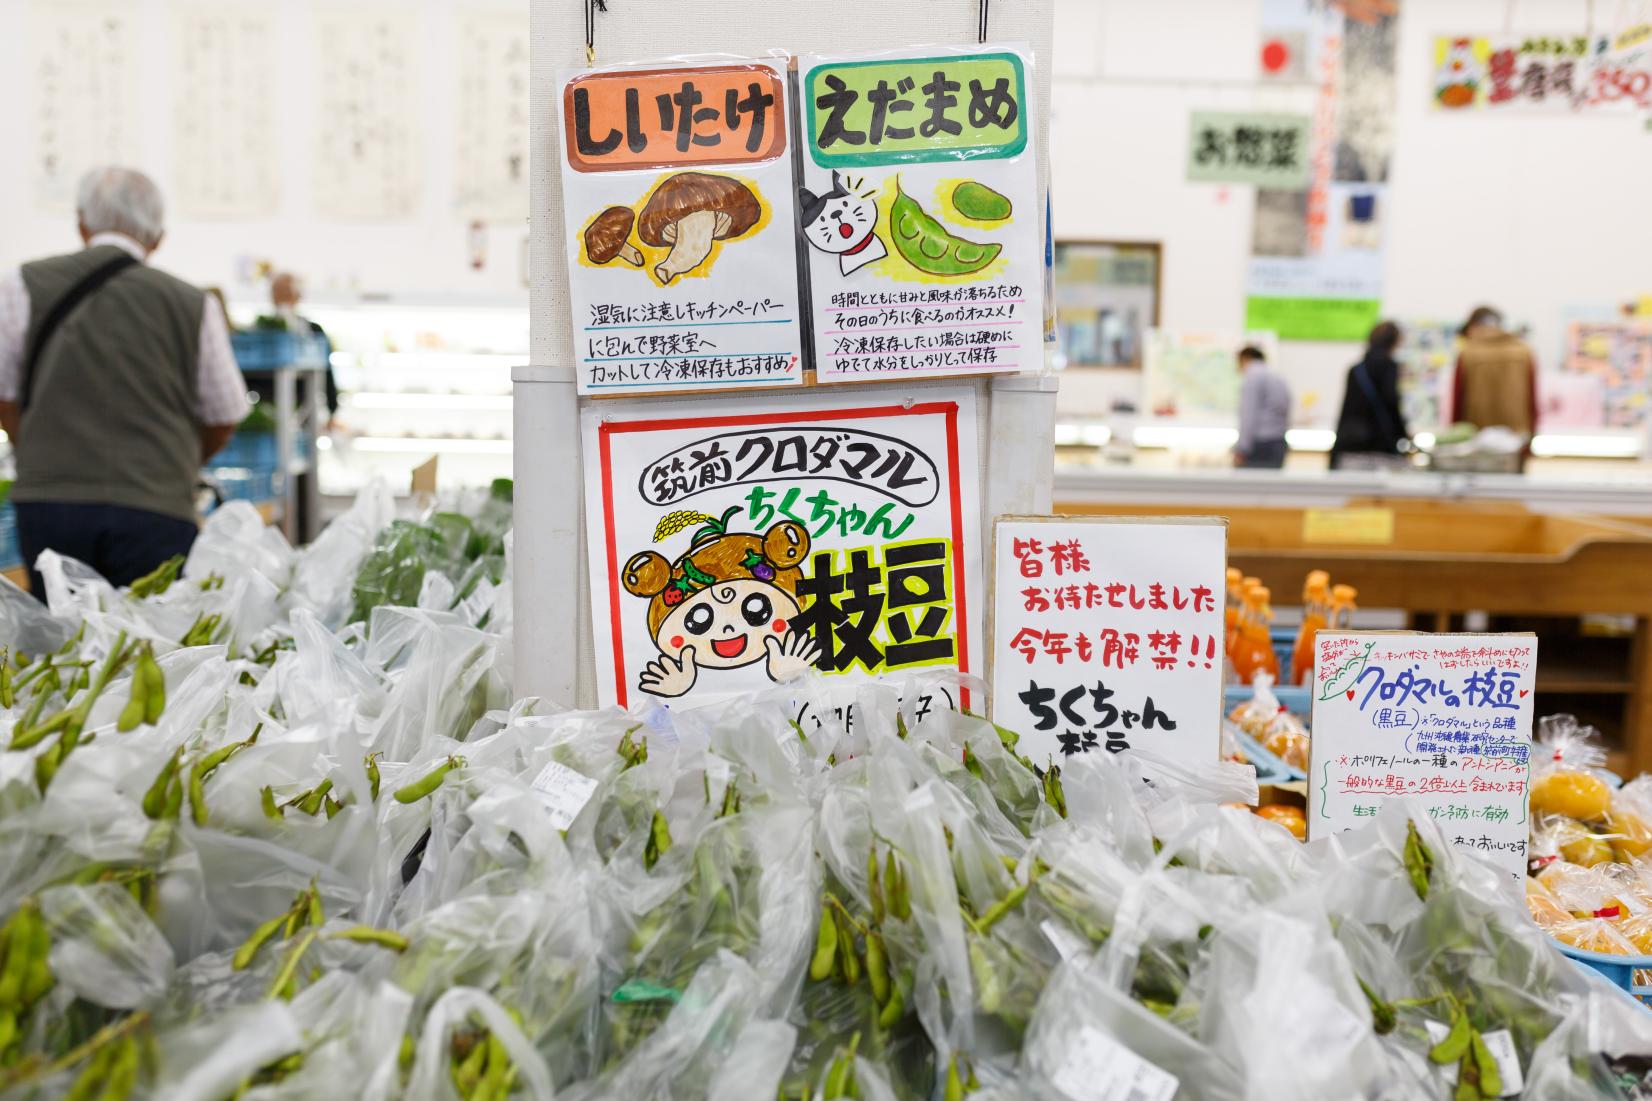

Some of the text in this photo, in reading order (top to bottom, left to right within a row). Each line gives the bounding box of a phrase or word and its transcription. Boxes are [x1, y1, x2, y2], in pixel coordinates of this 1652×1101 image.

[573, 81, 774, 156] しいたけ
[816, 71, 1018, 149] えだまめ
[590, 298, 784, 327] 湿気に注意しキッチンペーパー
[831, 285, 1023, 308] 時間とともに甘みと風味が落ちるため
[589, 331, 717, 359] に包んで野菜室へ
[834, 331, 1013, 355] 冷凍保存したい場合は硬めに
[835, 349, 998, 374] ゆでて水分をしっかりとって保存
[651, 433, 928, 502] 筑前クロダマル
[744, 485, 915, 540] ちくちゃん
[1013, 536, 1090, 578] 皆様
[787, 541, 955, 673] 枝豆
[1021, 581, 1216, 613] お待たせしました
[1018, 679, 1177, 731] ちくちゃん
[1357, 664, 1521, 711] クロダマルの枝豆
[1372, 706, 1419, 731] (黒豆)
